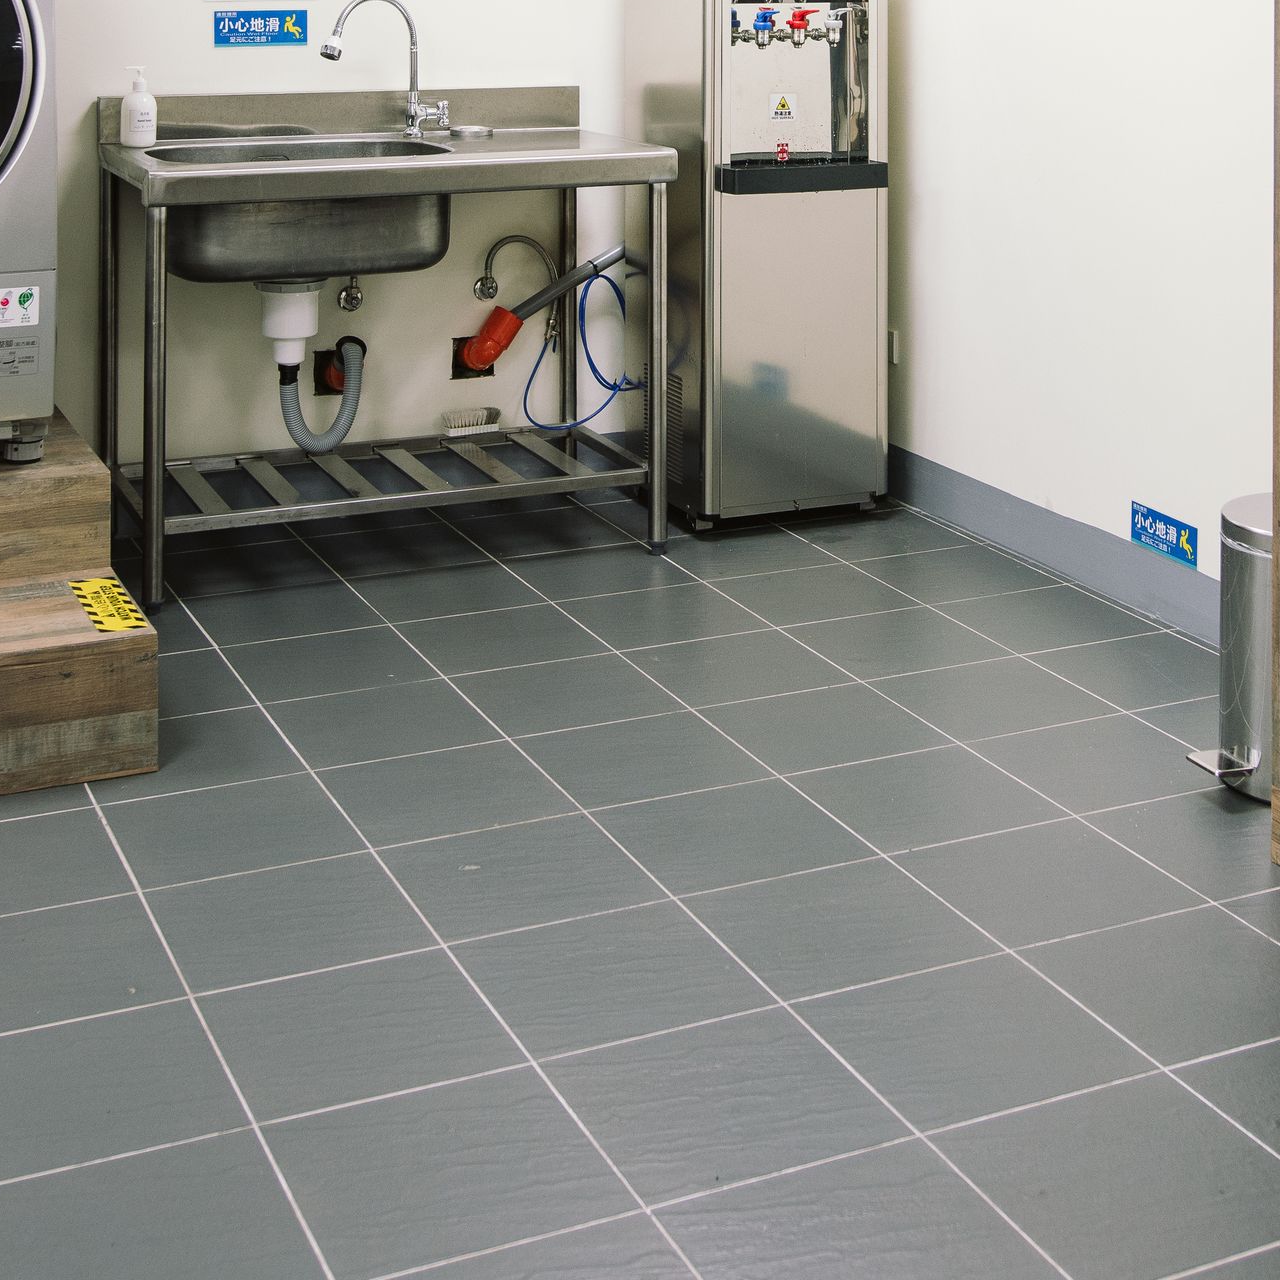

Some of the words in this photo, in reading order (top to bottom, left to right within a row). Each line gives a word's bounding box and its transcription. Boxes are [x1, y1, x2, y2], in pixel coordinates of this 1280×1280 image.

[218, 17, 280, 33] 小心地滑
[1135, 511, 1177, 544] 小心地滑
